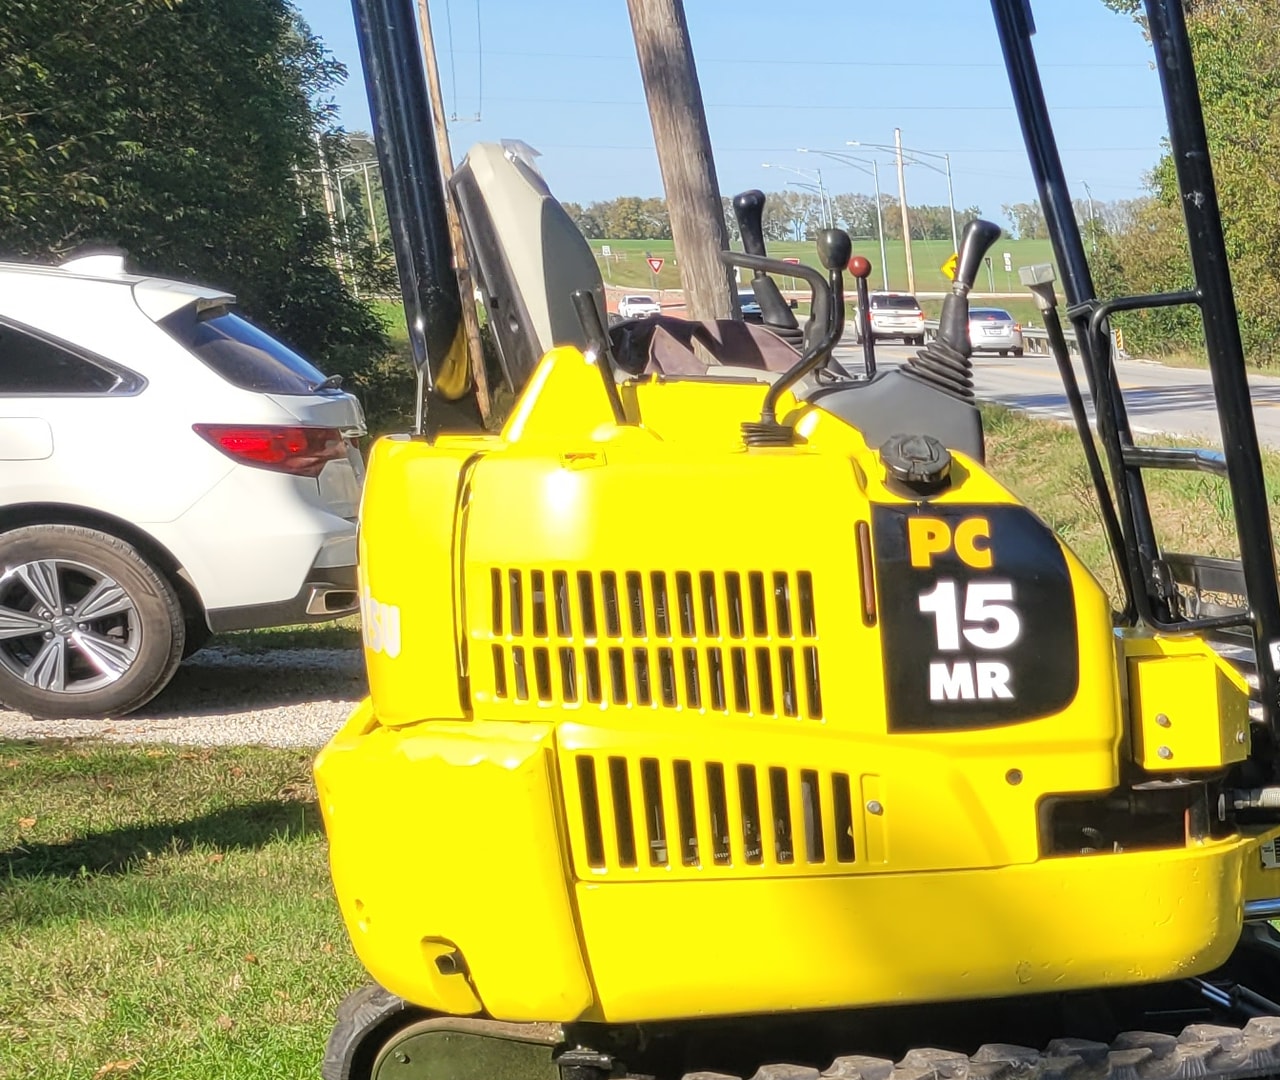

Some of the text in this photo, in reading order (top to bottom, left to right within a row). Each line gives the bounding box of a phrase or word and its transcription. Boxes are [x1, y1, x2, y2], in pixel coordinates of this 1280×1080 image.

[907, 516, 994, 569] PC
[918, 581, 1021, 651] 15
[929, 661, 1015, 701] MR
